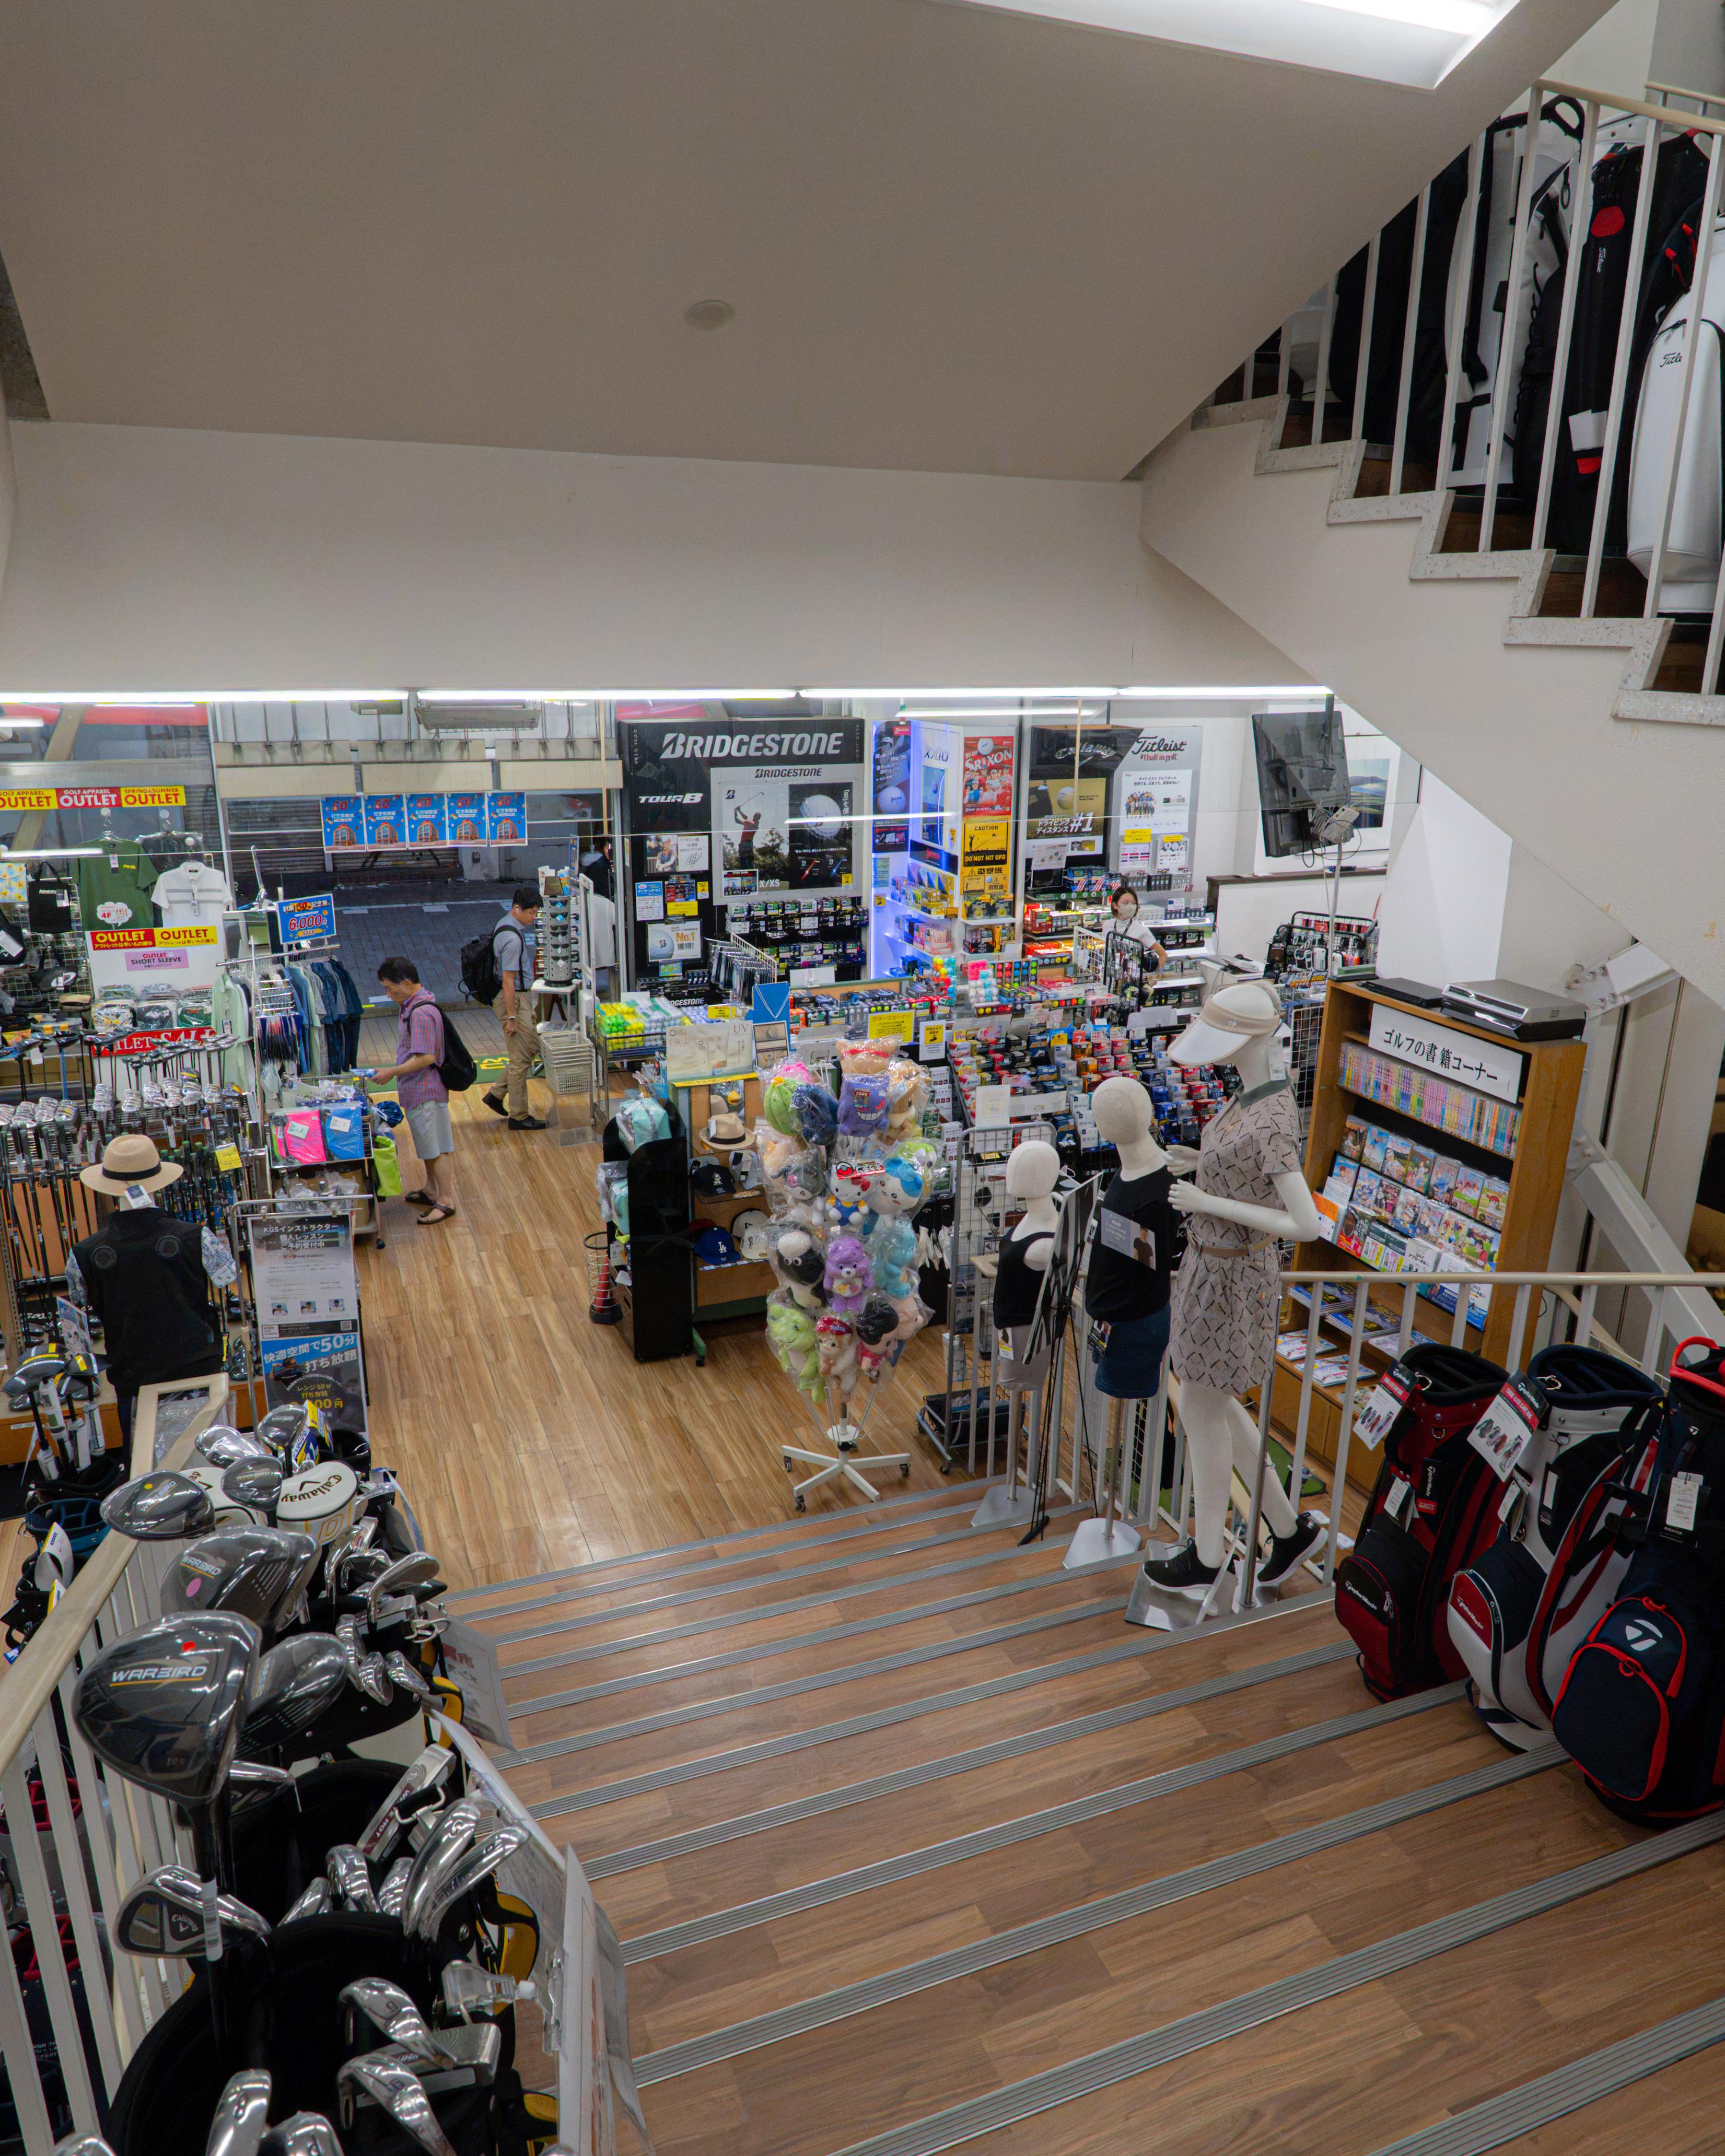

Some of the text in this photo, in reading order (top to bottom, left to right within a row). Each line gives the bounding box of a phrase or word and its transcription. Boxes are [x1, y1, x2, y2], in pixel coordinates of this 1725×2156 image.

[1660, 352, 1683, 368] Title
[660, 732, 844, 759] BRIDGESTONE
[1132, 736, 1187, 754] Titleist
[924, 748, 949, 762] XXIO
[965, 747, 1012, 774] SRIXON
[1165, 754, 1178, 762] golf
[754, 768, 823, 778] BRIDGESTONE
[60, 794, 118, 807] OUTLET
[124, 793, 180, 805] OUTLET
[375, 798, 390, 810] 60
[416, 797, 432, 808] 60
[457, 796, 472, 808] 60
[497, 795, 512, 806] 60
[332, 801, 347, 812] 60
[1038, 818, 1070, 827] ドライビング
[1070, 812, 1094, 832] #1
[760, 879, 780, 888] X/XS
[96, 931, 145, 943] OUTLET
[160, 929, 208, 940] OUTLET
[676, 932, 695, 942] No.1
[95, 941, 153, 949] アウトレットは早いもの勝ち
[670, 998, 705, 1006] DGESTONE
[733, 1024, 749, 1033] UV
[1383, 1029, 1498, 1081] ゴルフの書籍コーナー
[264, 1224, 339, 1233] KGSインストラクター
[280, 1233, 324, 1241] 個人レッスン
[281, 1241, 325, 1250] ご予約受付中
[718, 1241, 728, 1253] LA
[264, 1335, 355, 1364] 快適空間で50分
[305, 1348, 357, 1373] 打ち放題
[1518, 1382, 1540, 1410] TaylorMade
[236, 1470, 271, 1481] WARBIRD
[281, 1474, 342, 1503] Callaway
[140, 1480, 177, 1513] WARBIRD
[181, 1553, 223, 1577] WARBIRD
[1345, 1579, 1378, 1611] TaylorMade
[1456, 1595, 1485, 1631] TaylorMade
[111, 1666, 208, 1683] WARBIRD
